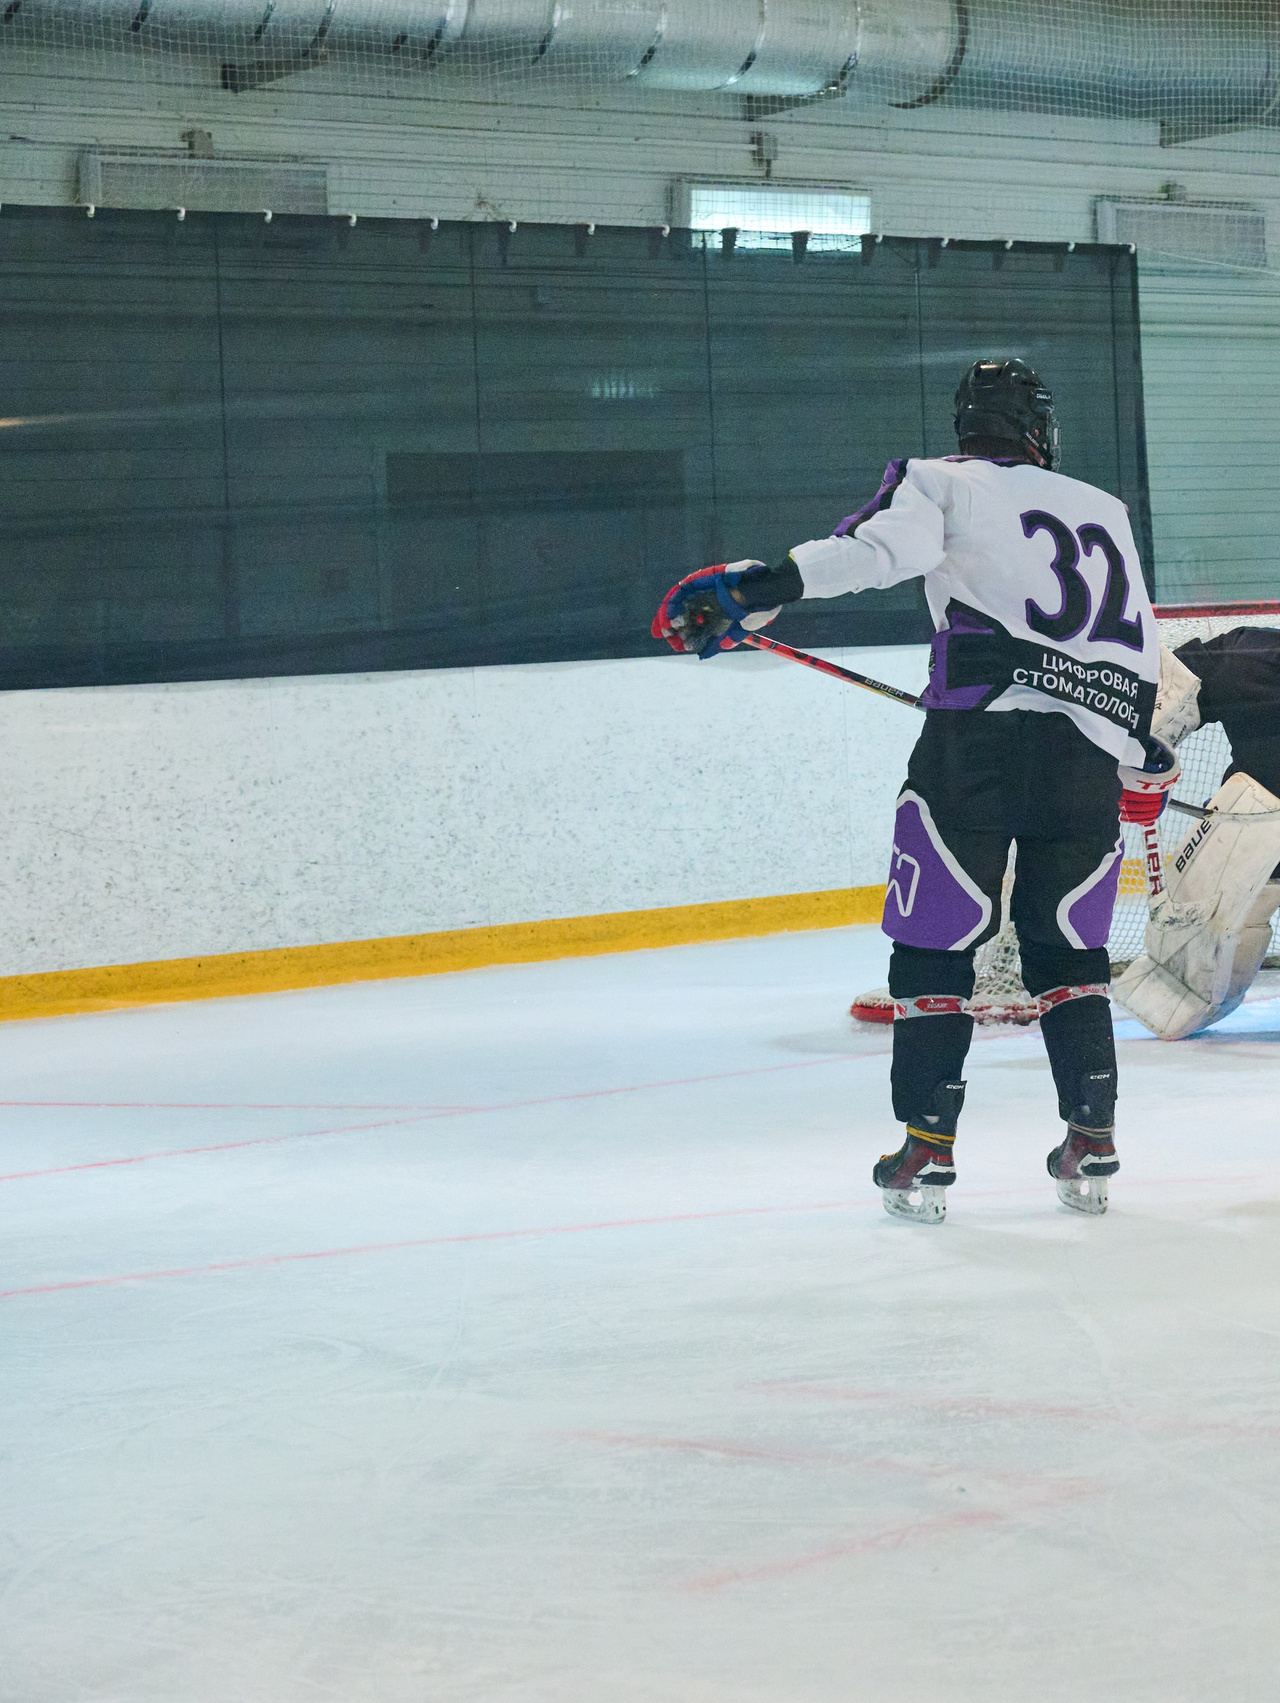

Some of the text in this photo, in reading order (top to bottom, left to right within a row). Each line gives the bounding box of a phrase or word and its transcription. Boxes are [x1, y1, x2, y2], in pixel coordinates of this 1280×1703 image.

[1020, 509, 1144, 653] 32
[1042, 653, 1139, 699] ЦИФРОВАЯ
[1175, 806, 1219, 874] BAUE
